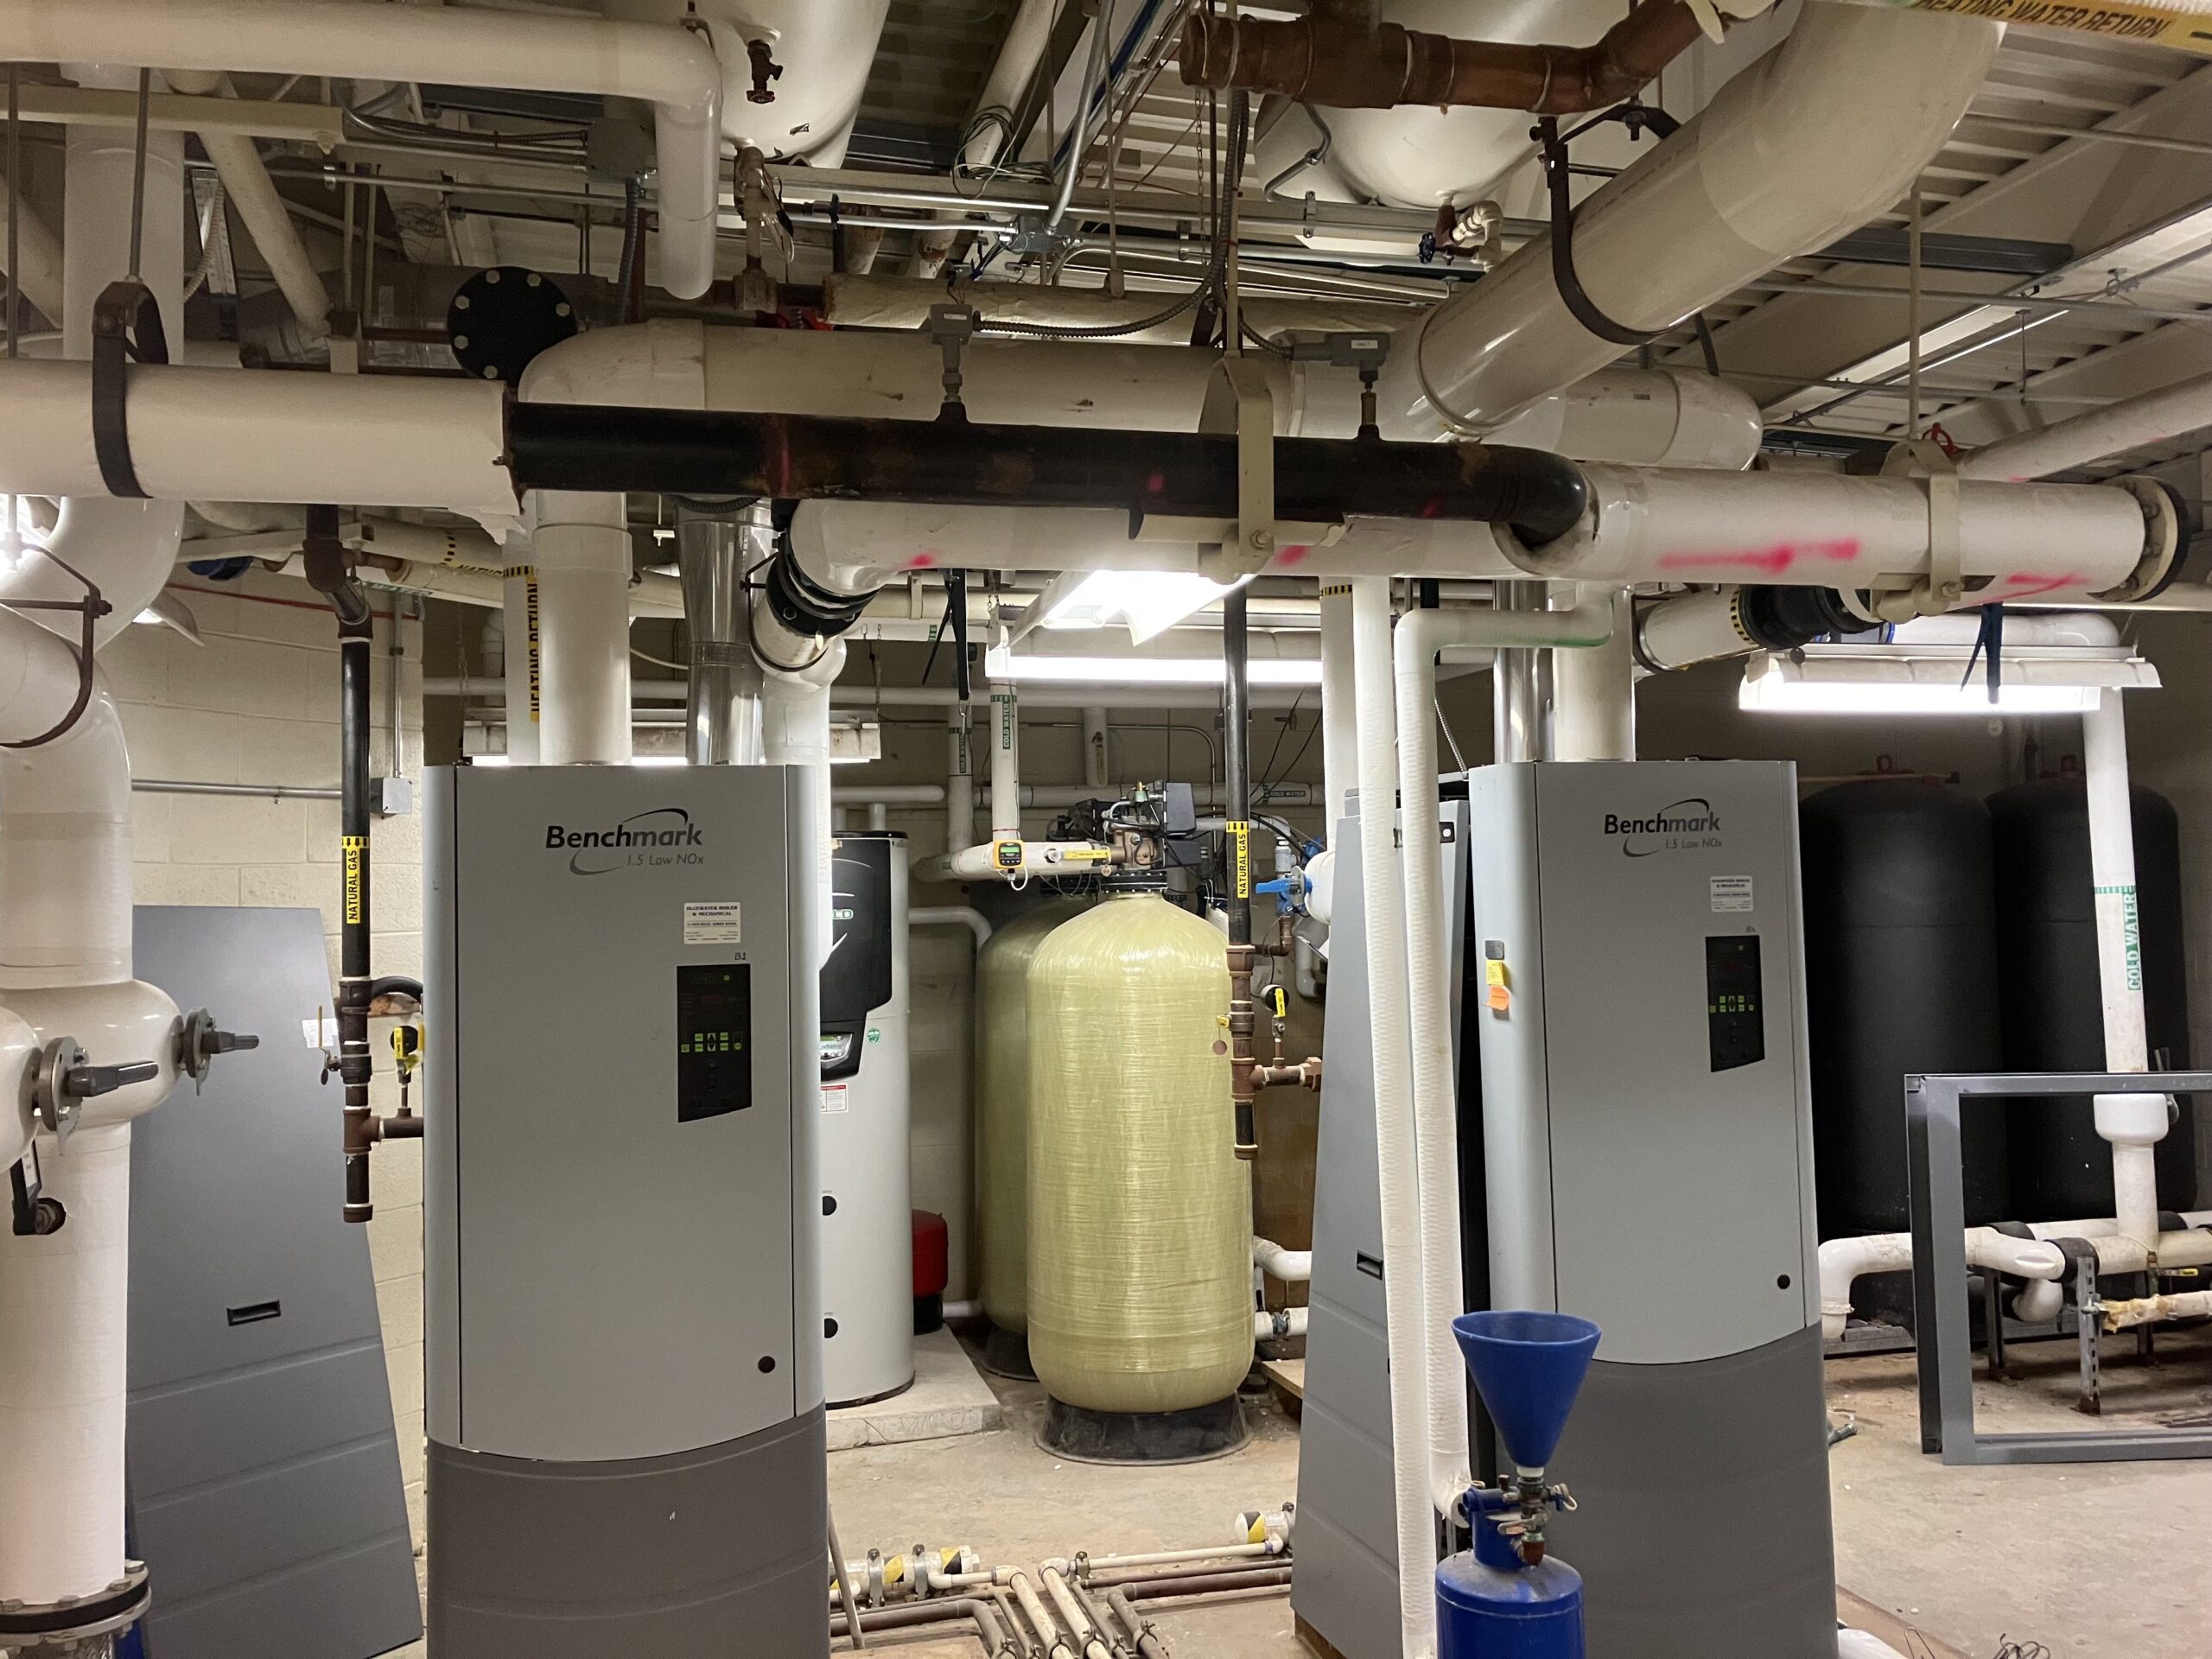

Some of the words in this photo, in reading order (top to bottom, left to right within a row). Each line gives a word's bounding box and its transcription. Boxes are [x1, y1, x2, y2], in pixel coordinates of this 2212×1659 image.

[2009, 1, 2088, 28] WATER
[2086, 10, 2172, 38] RETURN
[1605, 811, 1721, 834] Benchmark
[545, 823, 703, 849] Benchmark
[1238, 834, 1247, 851] GAS
[1681, 839, 1700, 849] Low
[1702, 837, 1723, 848] NOx
[348, 850, 357, 870] GAS
[627, 854, 644, 867] 1.5
[649, 855, 672, 866] Low
[677, 853, 705, 865] NOx
[1238, 854, 1247, 894] NATURAL
[348, 874, 358, 920] NATURAL
[2124, 893, 2139, 947] WATER
[2126, 950, 2141, 990] COLD
